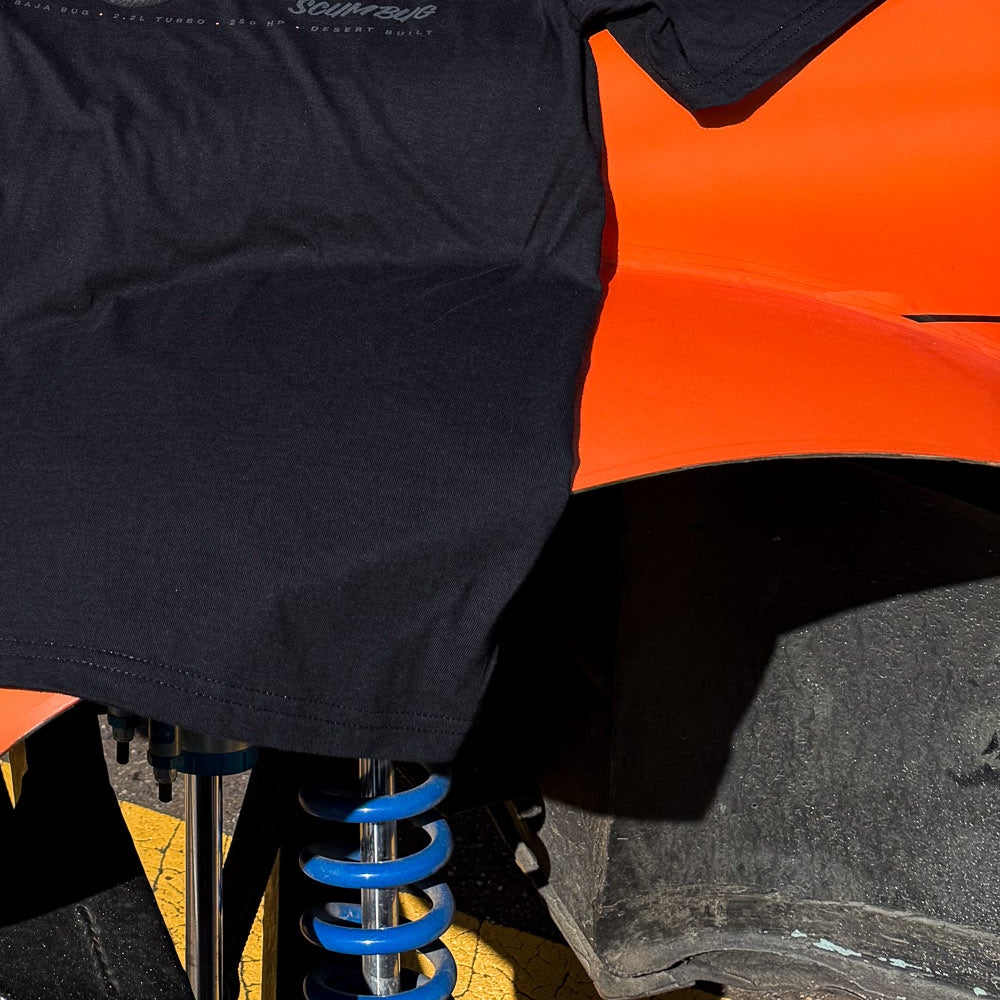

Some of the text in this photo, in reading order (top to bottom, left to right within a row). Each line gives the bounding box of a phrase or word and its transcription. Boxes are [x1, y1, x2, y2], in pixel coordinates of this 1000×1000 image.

[14, 0, 50, 11] BAJA
[60, 6, 89, 16] BUG
[112, 13, 145, 22] 2.2L
[156, 16, 205, 25] TURBO
[229, 18, 257, 26] 250
[266, 19, 286, 27] HP
[384, 29, 433, 37] BUILT
